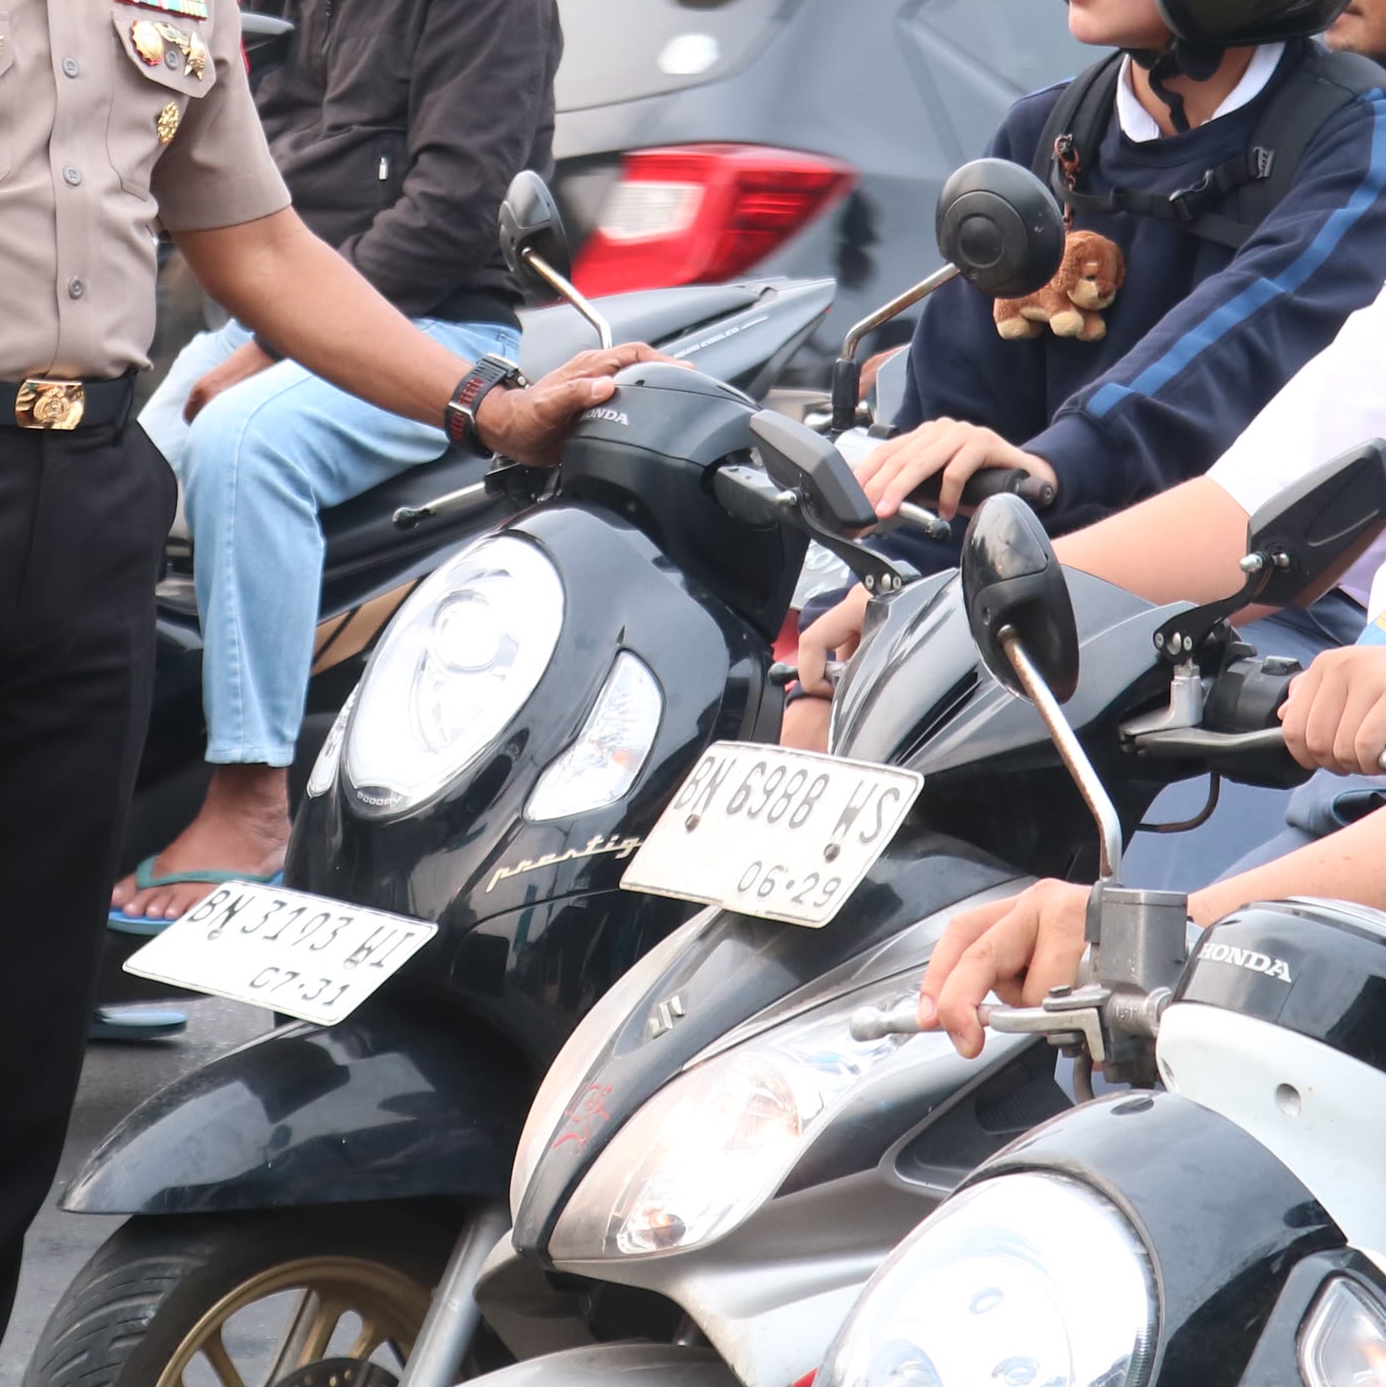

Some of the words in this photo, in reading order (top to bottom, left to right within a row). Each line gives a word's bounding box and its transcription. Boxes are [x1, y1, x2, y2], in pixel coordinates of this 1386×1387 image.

[674, 756, 736, 813] BN
[726, 761, 830, 829] 6988
[188, 889, 256, 928] BN
[1198, 942, 1293, 983] HONDA
